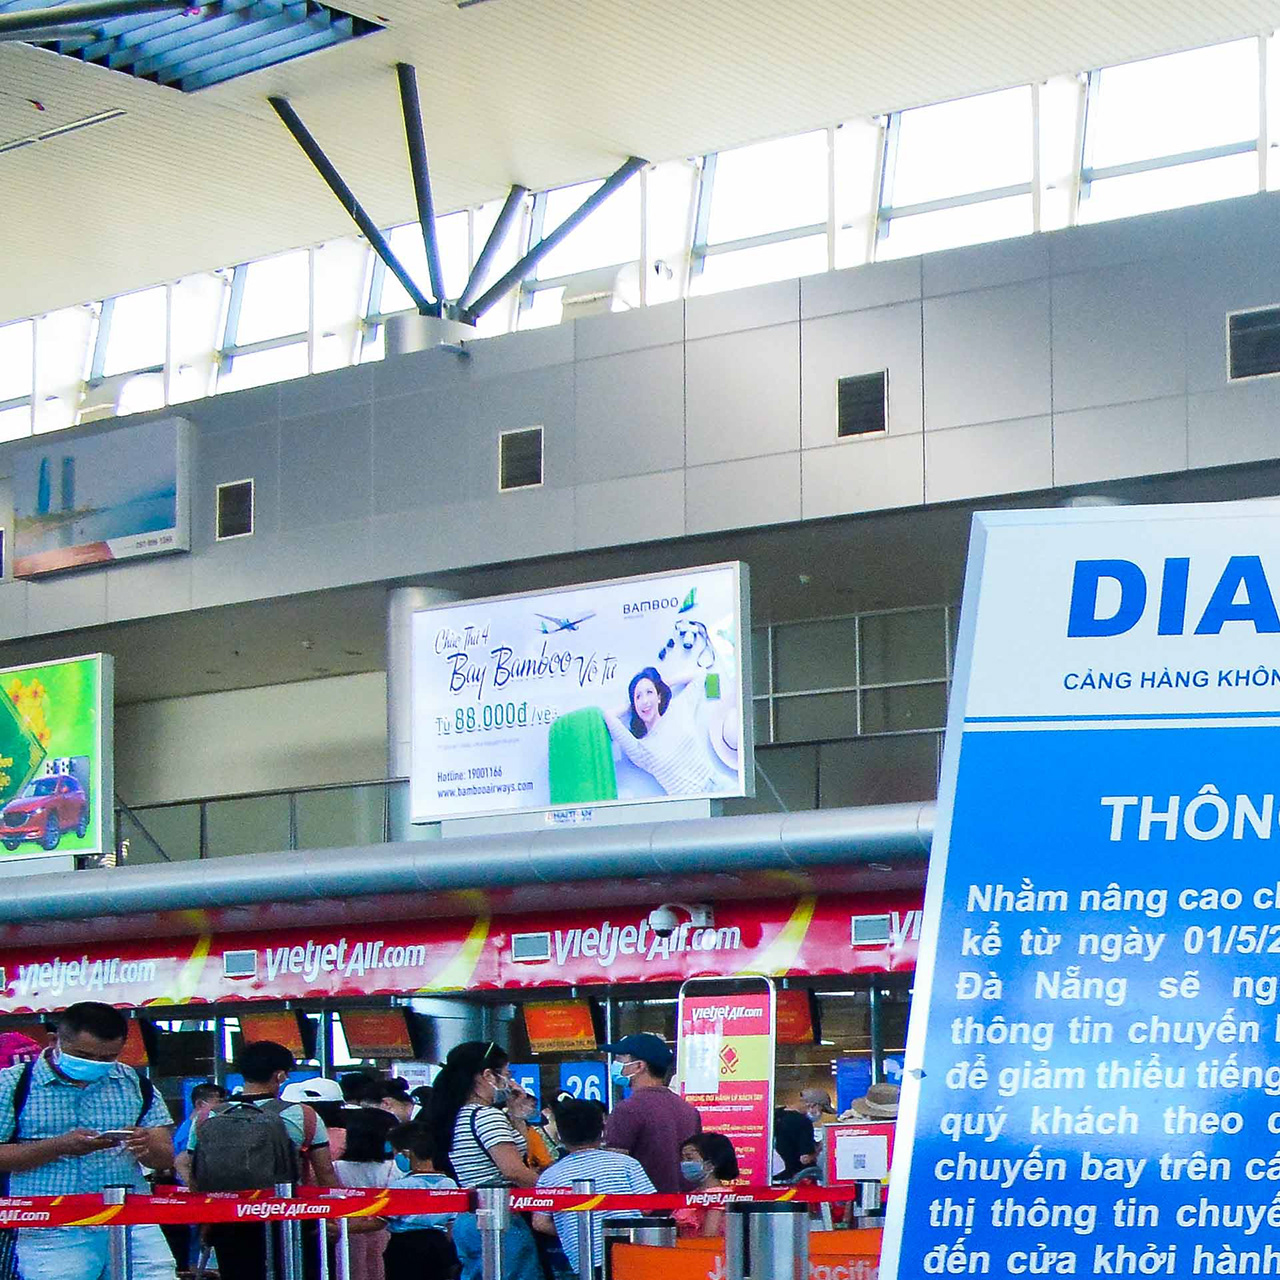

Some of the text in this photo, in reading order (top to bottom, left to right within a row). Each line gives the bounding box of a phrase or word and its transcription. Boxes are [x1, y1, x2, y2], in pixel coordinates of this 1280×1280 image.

[623, 597, 679, 615] BAMBOO
[447, 651, 487, 700] Bay
[491, 640, 573, 688] Bamboo
[1064, 667, 1131, 690] CẢNG
[1141, 666, 1208, 688] HÀNG
[436, 764, 504, 784] Hotline: 19001166
[967, 878, 1068, 911] Nhằm
[1080, 883, 1168, 917] nâng
[1179, 889, 1242, 910] cao
[962, 921, 1002, 955] kể
[1021, 927, 1061, 955] từ
[1078, 926, 1166, 962] ngày
[567, 1075, 601, 1102] 26
[924, 1237, 990, 1273] đến
[1007, 1244, 1076, 1274] cửa
[1093, 1244, 1176, 1274] khởi
